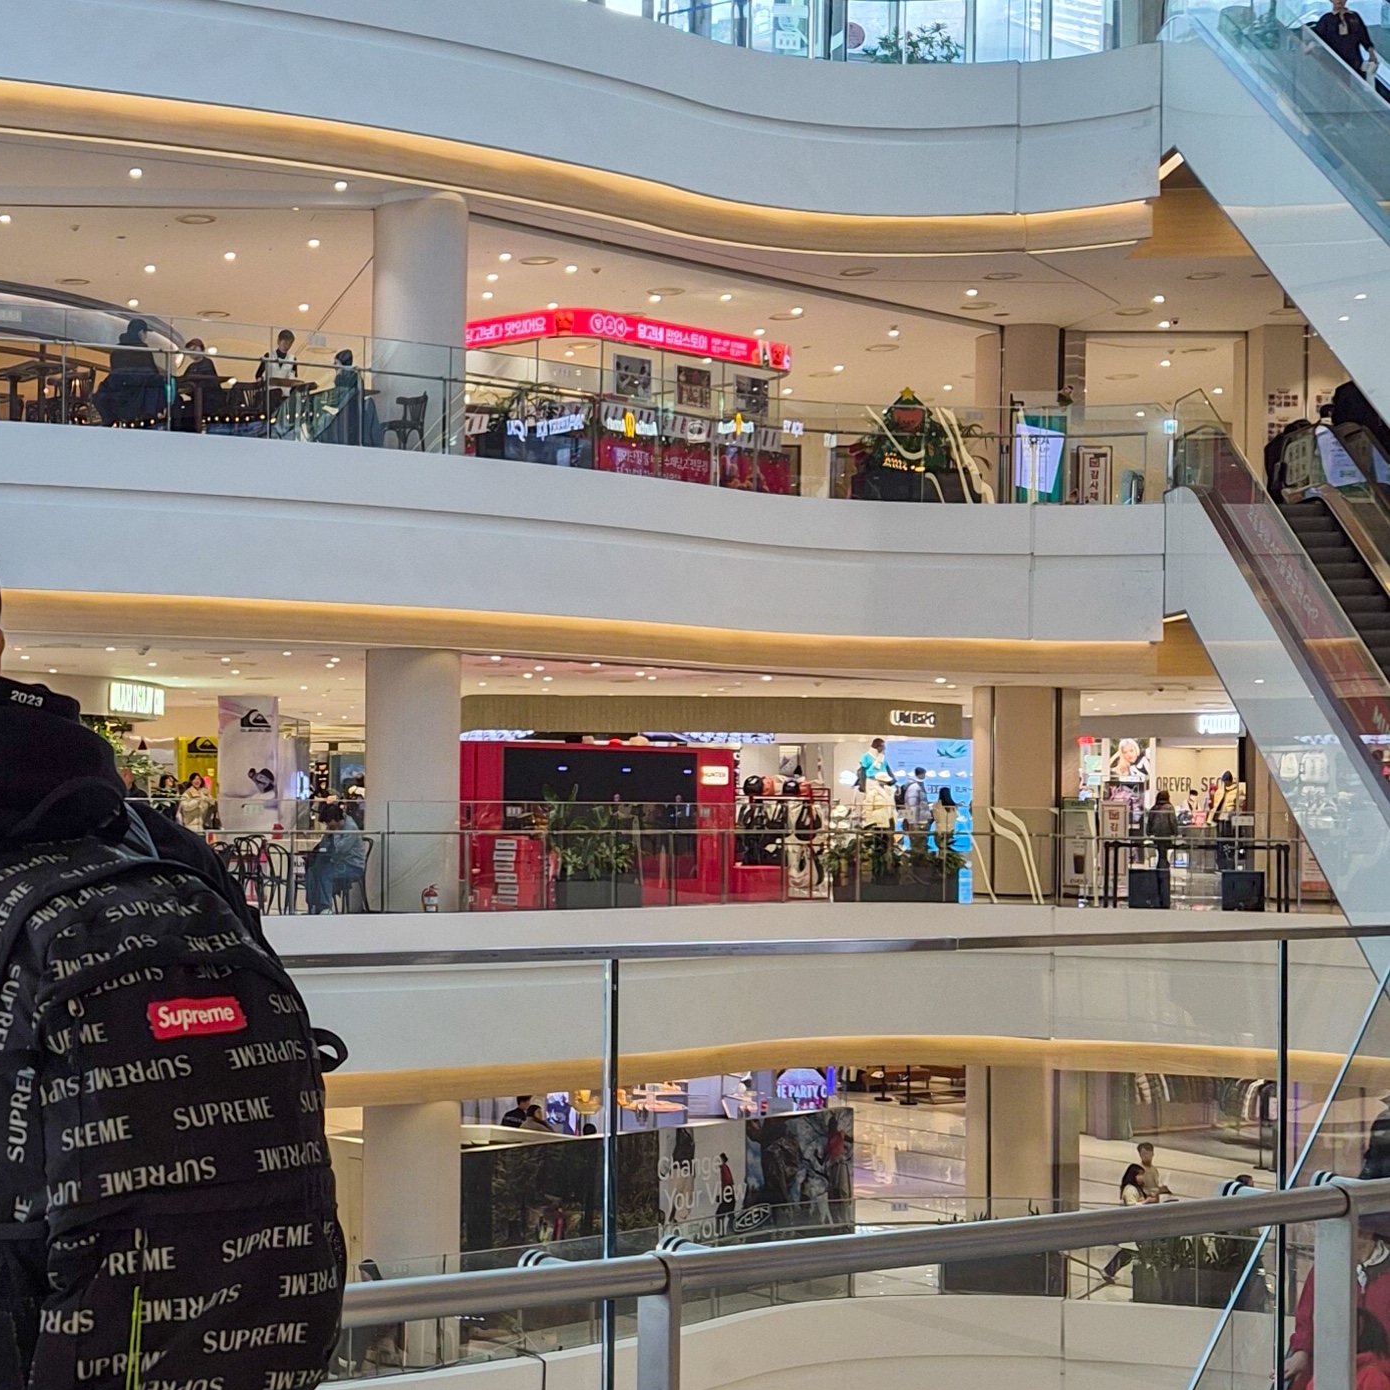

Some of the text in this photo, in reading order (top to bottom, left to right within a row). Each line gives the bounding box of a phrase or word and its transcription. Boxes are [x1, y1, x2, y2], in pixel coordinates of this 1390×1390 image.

[10, 690, 44, 707] 2023
[157, 1005, 235, 1031] Supreme
[226, 1039, 307, 1070] SUPREME
[84, 1055, 192, 1094] SUPREME
[788, 1084, 819, 1098] PARTY
[173, 1096, 275, 1131] SUPREME
[98, 1156, 217, 1198] SUPREME
[658, 1155, 722, 1180] Change
[664, 1182, 748, 1211] Your View
[735, 1205, 769, 1229] KEEN
[222, 1223, 313, 1263] SUPREME
[203, 1322, 309, 1353] SUPREME
